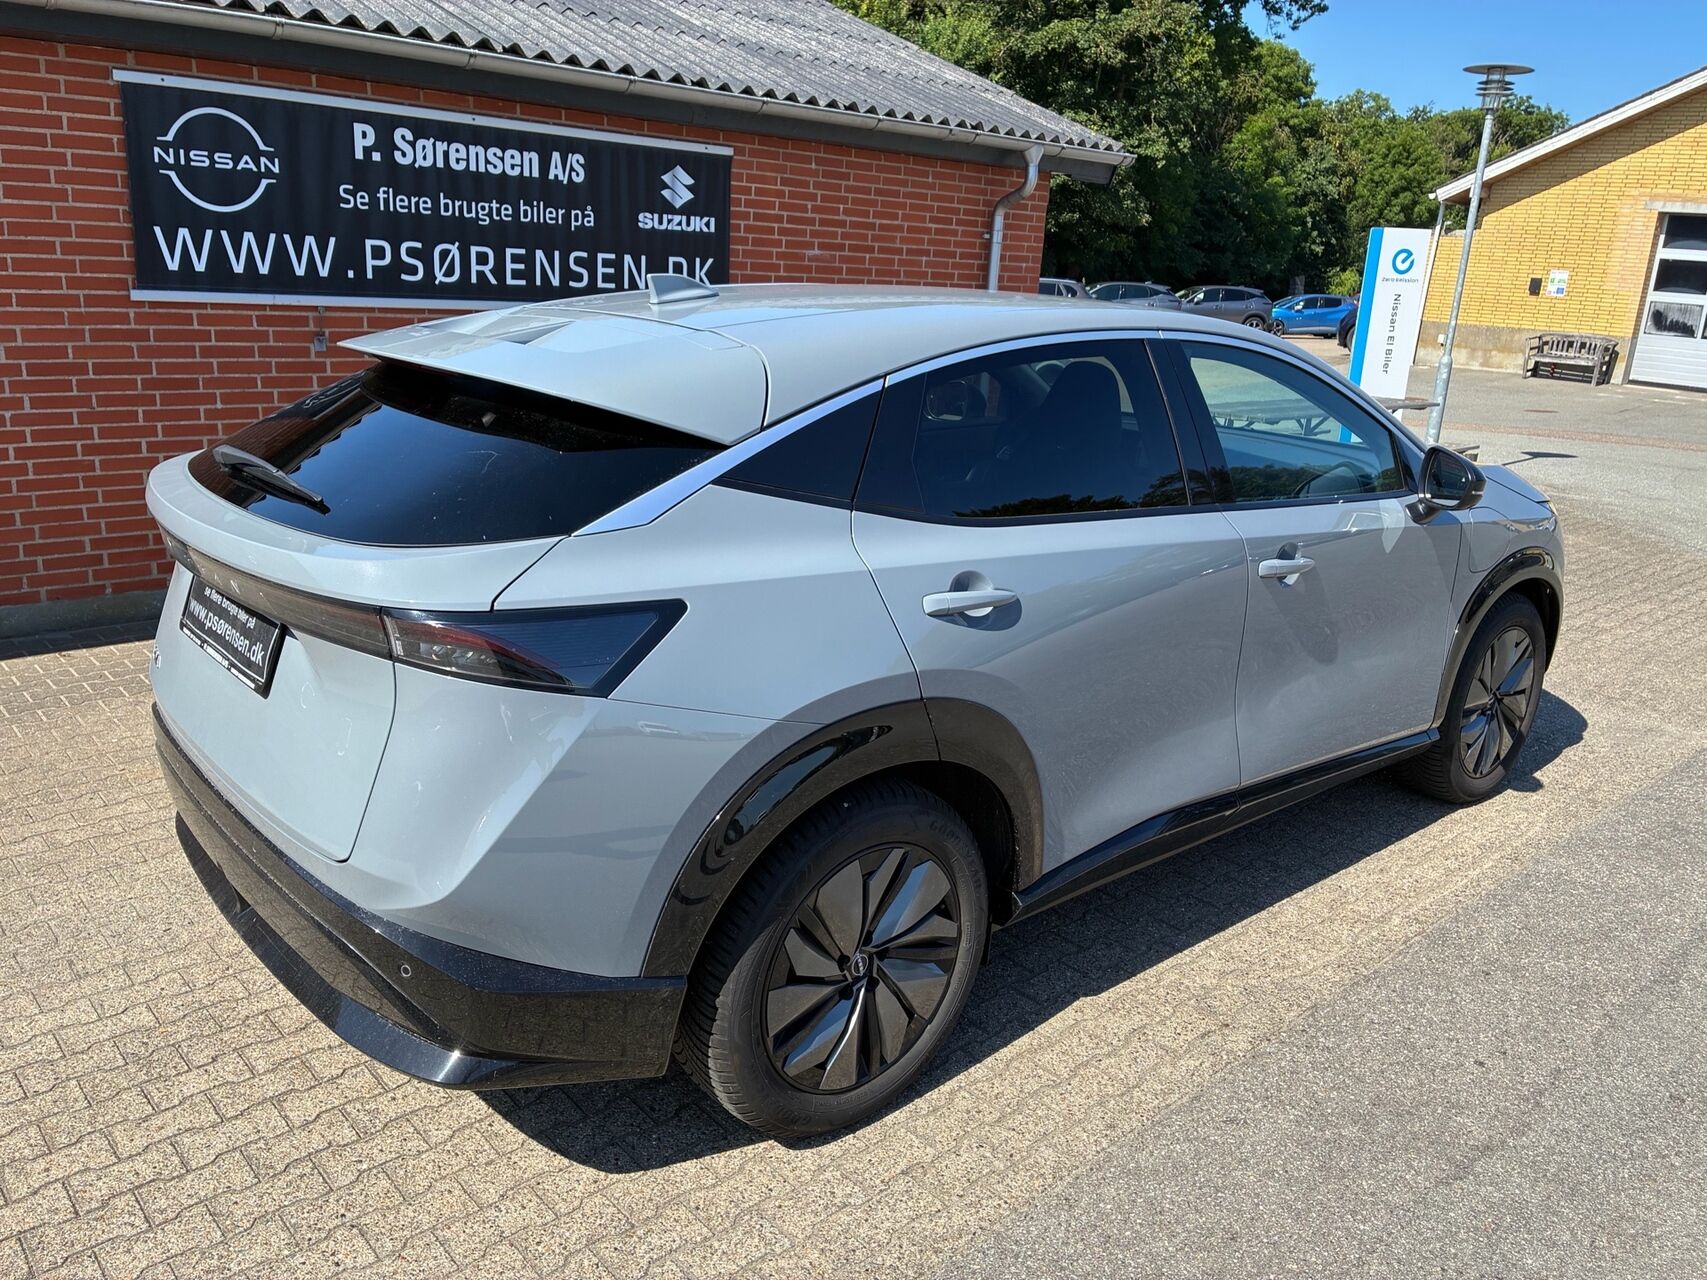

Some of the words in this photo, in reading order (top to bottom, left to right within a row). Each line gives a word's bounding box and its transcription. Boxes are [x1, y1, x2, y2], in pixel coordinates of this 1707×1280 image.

[153, 146, 280, 173] NISSAN
[353, 122, 381, 162] P.
[393, 127, 539, 178] Sørensen
[549, 151, 585, 184] A/S
[339, 184, 369, 209] Se
[377, 186, 432, 214] flere
[440, 192, 512, 225] brugte
[520, 200, 565, 225] biler
[571, 205, 594, 231] på
[638, 212, 716, 233] SUZUKI
[153, 225, 714, 290] WWW.PSØRENSENDK
[1388, 293, 1401, 332] Nissan
[1386, 335, 1395, 345] El
[1382, 348, 1393, 374] Biler
[189, 599, 265, 667] www.psørensen.dk
